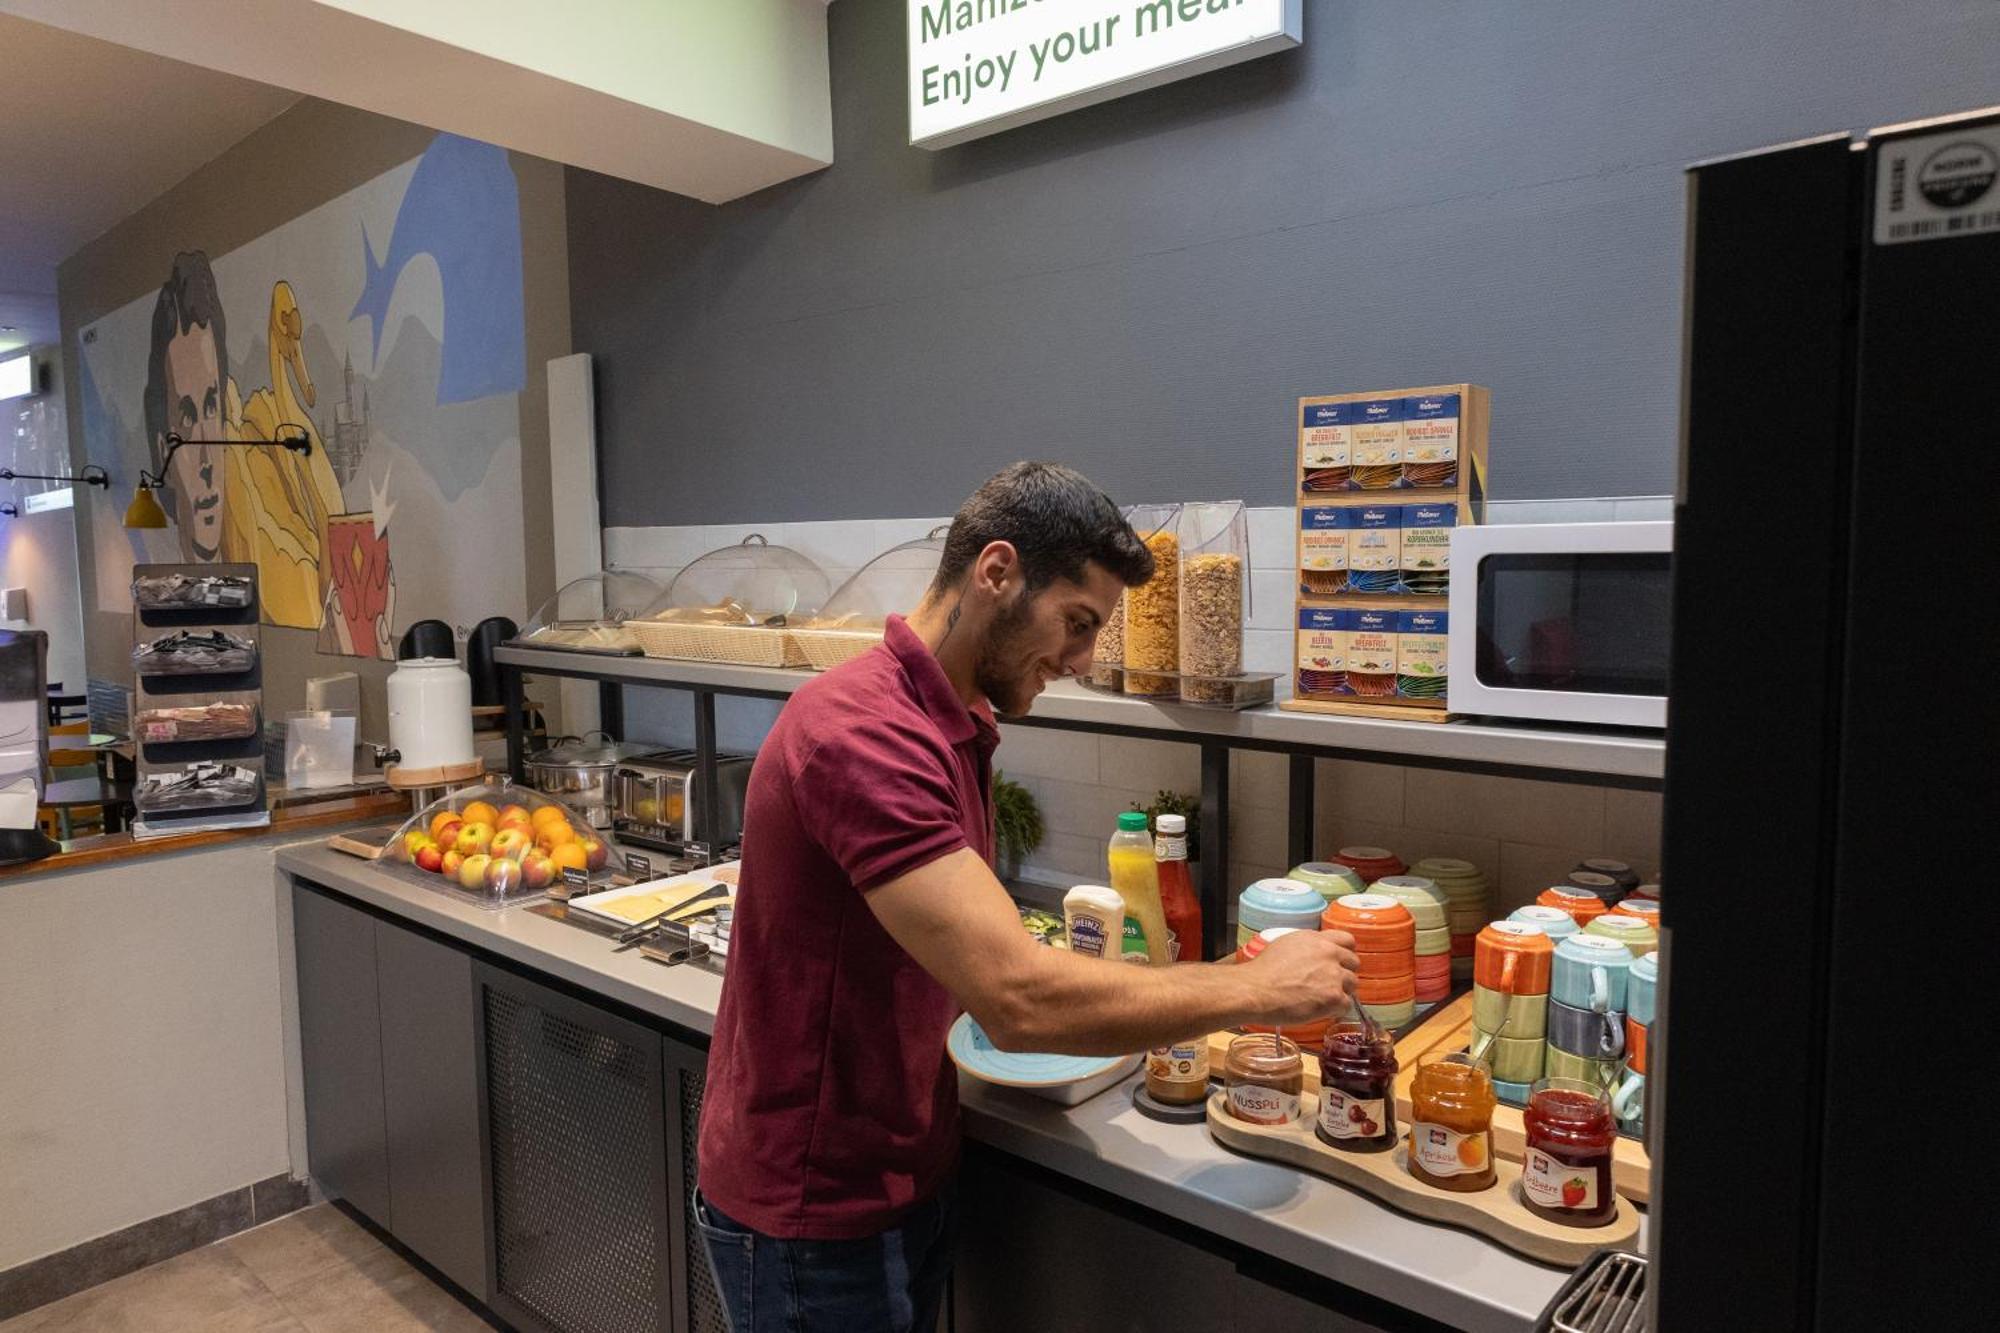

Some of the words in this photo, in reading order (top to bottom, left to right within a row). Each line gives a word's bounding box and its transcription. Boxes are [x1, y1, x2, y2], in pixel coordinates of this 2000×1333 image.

[922, 50, 1018, 107] Enjoy
[1029, 15, 1121, 82] your
[1135, 0, 1244, 38] me
[1075, 917, 1101, 931] HEINZ
